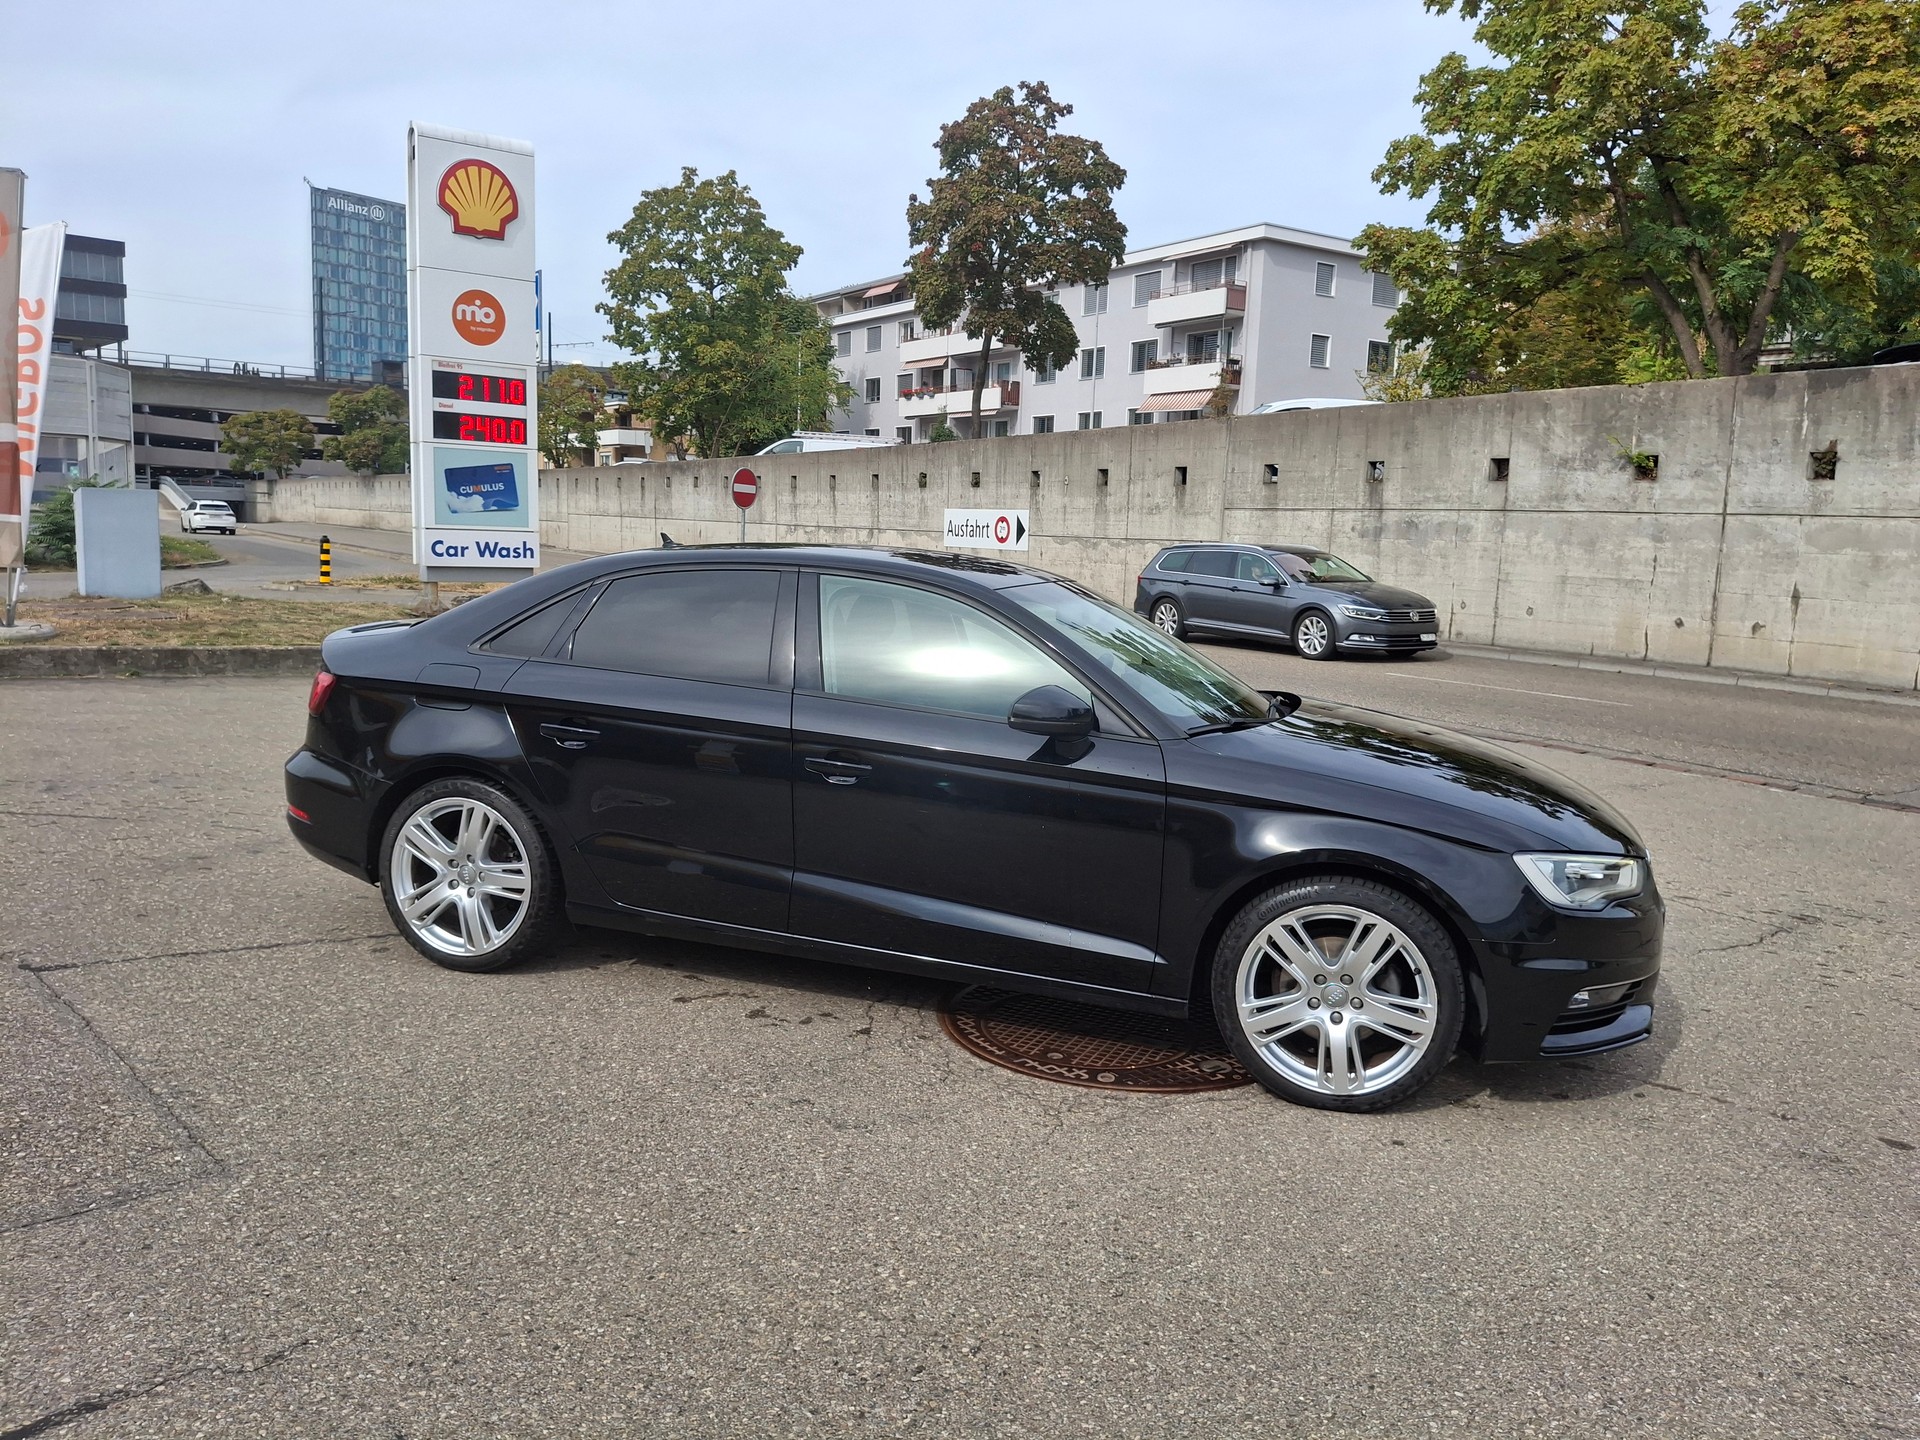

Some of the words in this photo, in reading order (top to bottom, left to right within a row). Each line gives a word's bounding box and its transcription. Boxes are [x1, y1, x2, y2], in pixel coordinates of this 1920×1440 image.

[328, 197, 368, 216] Allianz
[457, 299, 496, 324] mio
[458, 375, 524, 405] 211.0
[460, 415, 525, 444] 240.0
[460, 482, 505, 494] CUMULUS
[947, 519, 990, 538] Ausfahrt
[431, 539, 469, 558] Car
[475, 541, 535, 559] Wash
